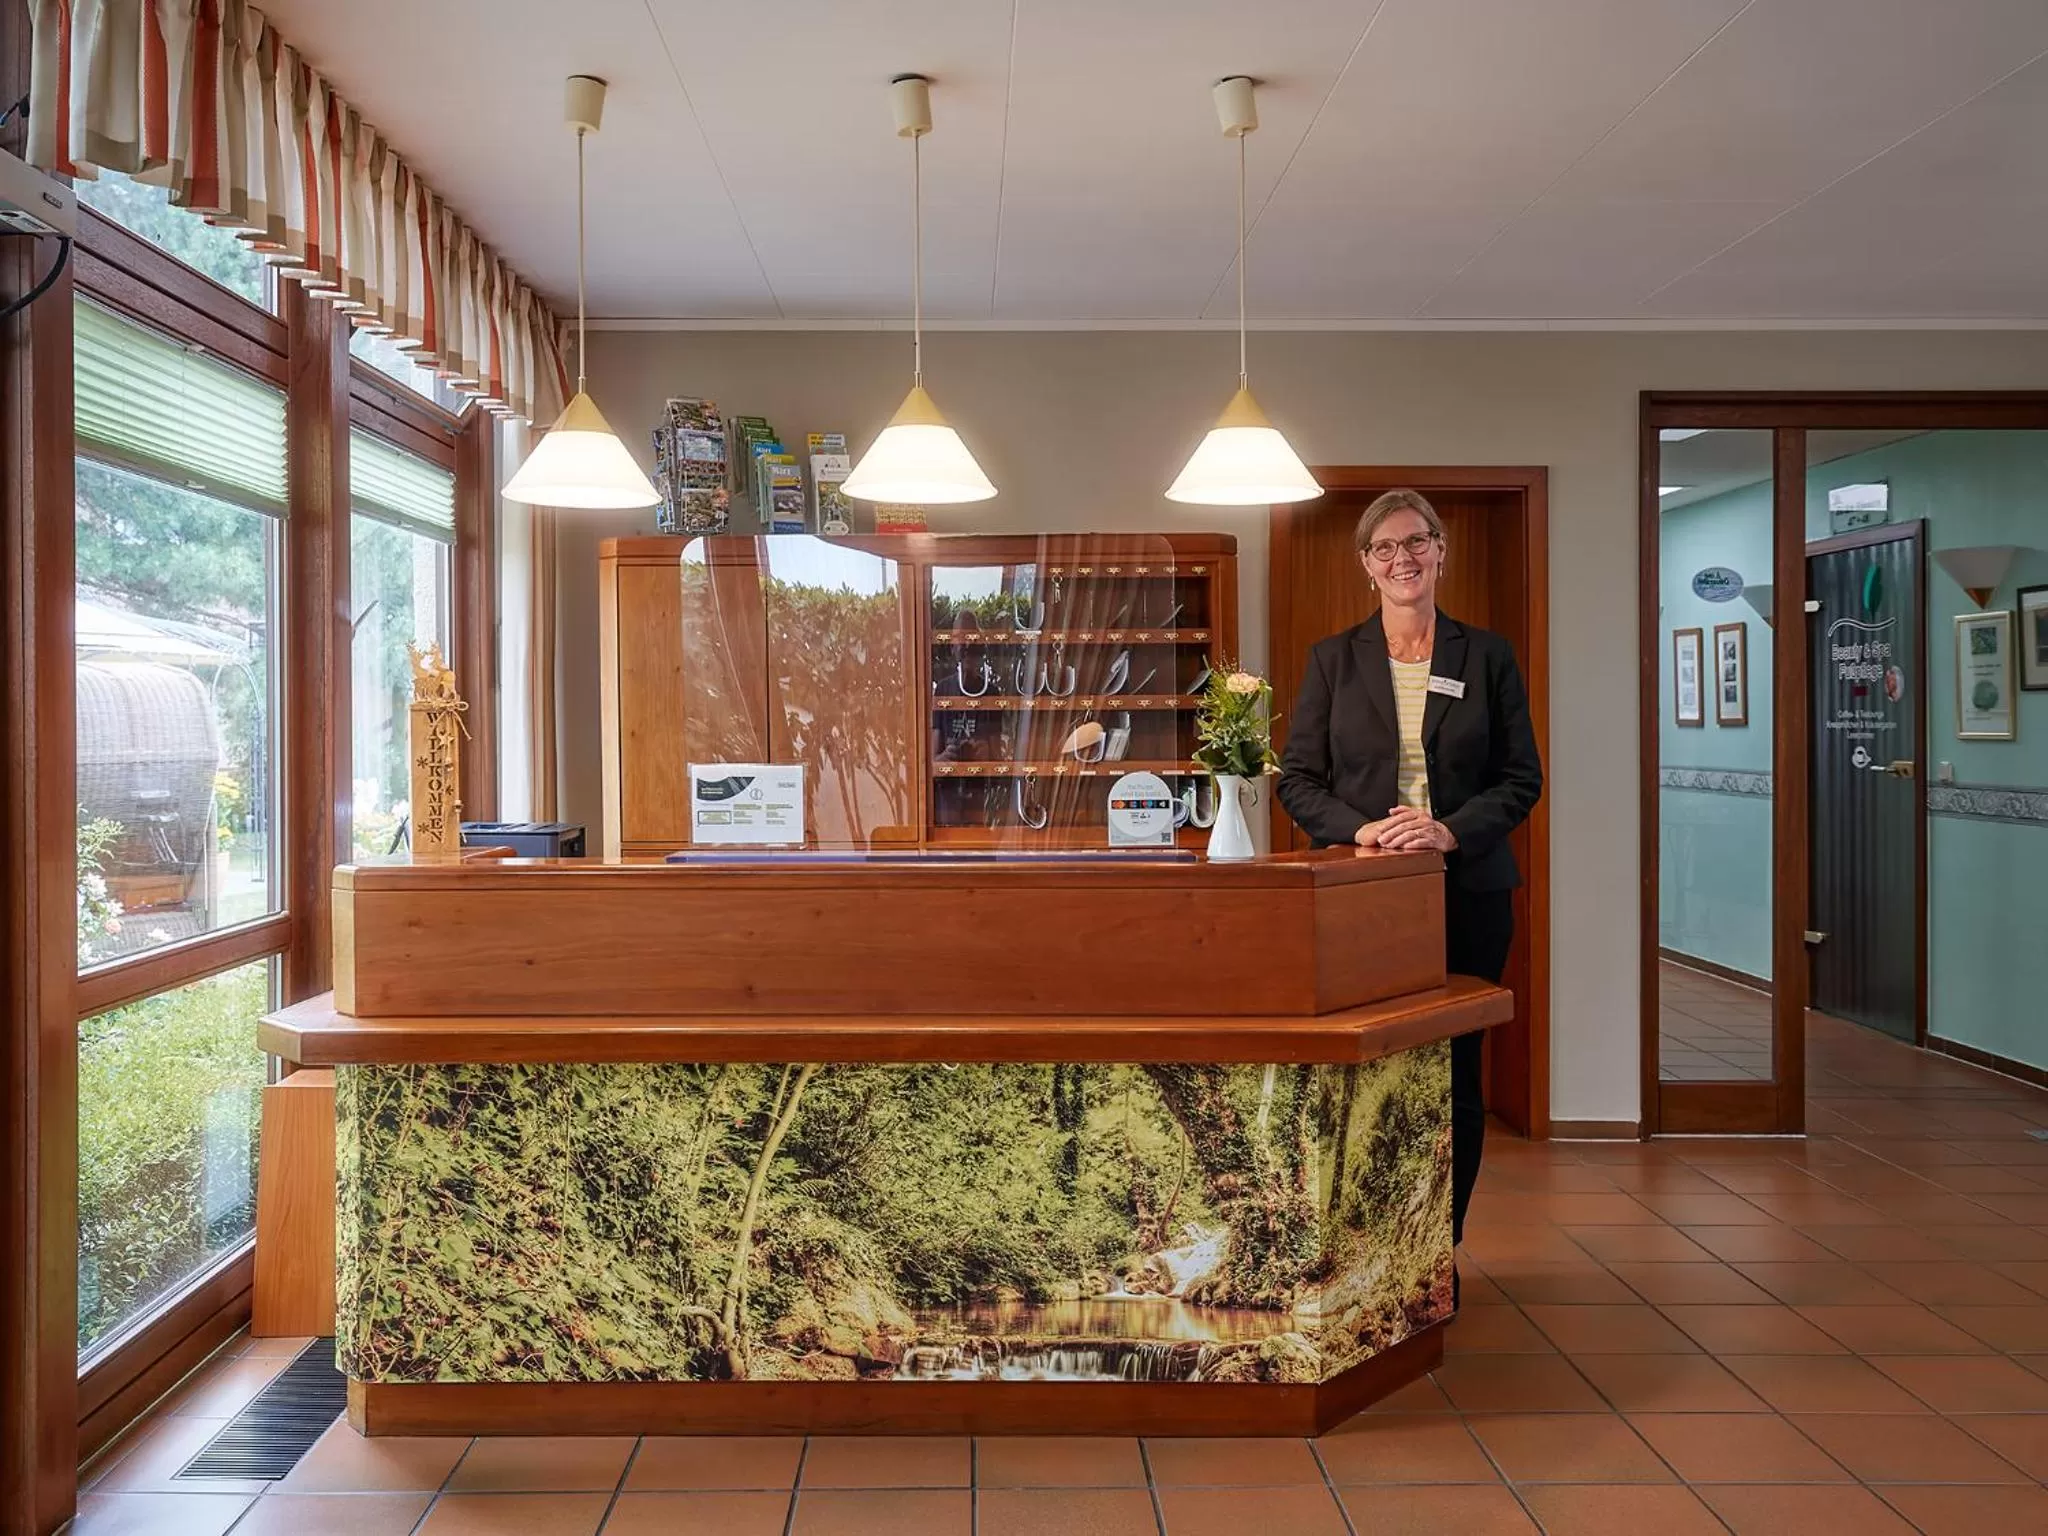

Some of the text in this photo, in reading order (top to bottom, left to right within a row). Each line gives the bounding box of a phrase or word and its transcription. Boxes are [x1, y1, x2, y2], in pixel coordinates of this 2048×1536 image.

[1832, 643, 1863, 662] Beauty
[1872, 641, 1892, 661] Spa
[426, 712, 443, 843] WILLKOMMEN
